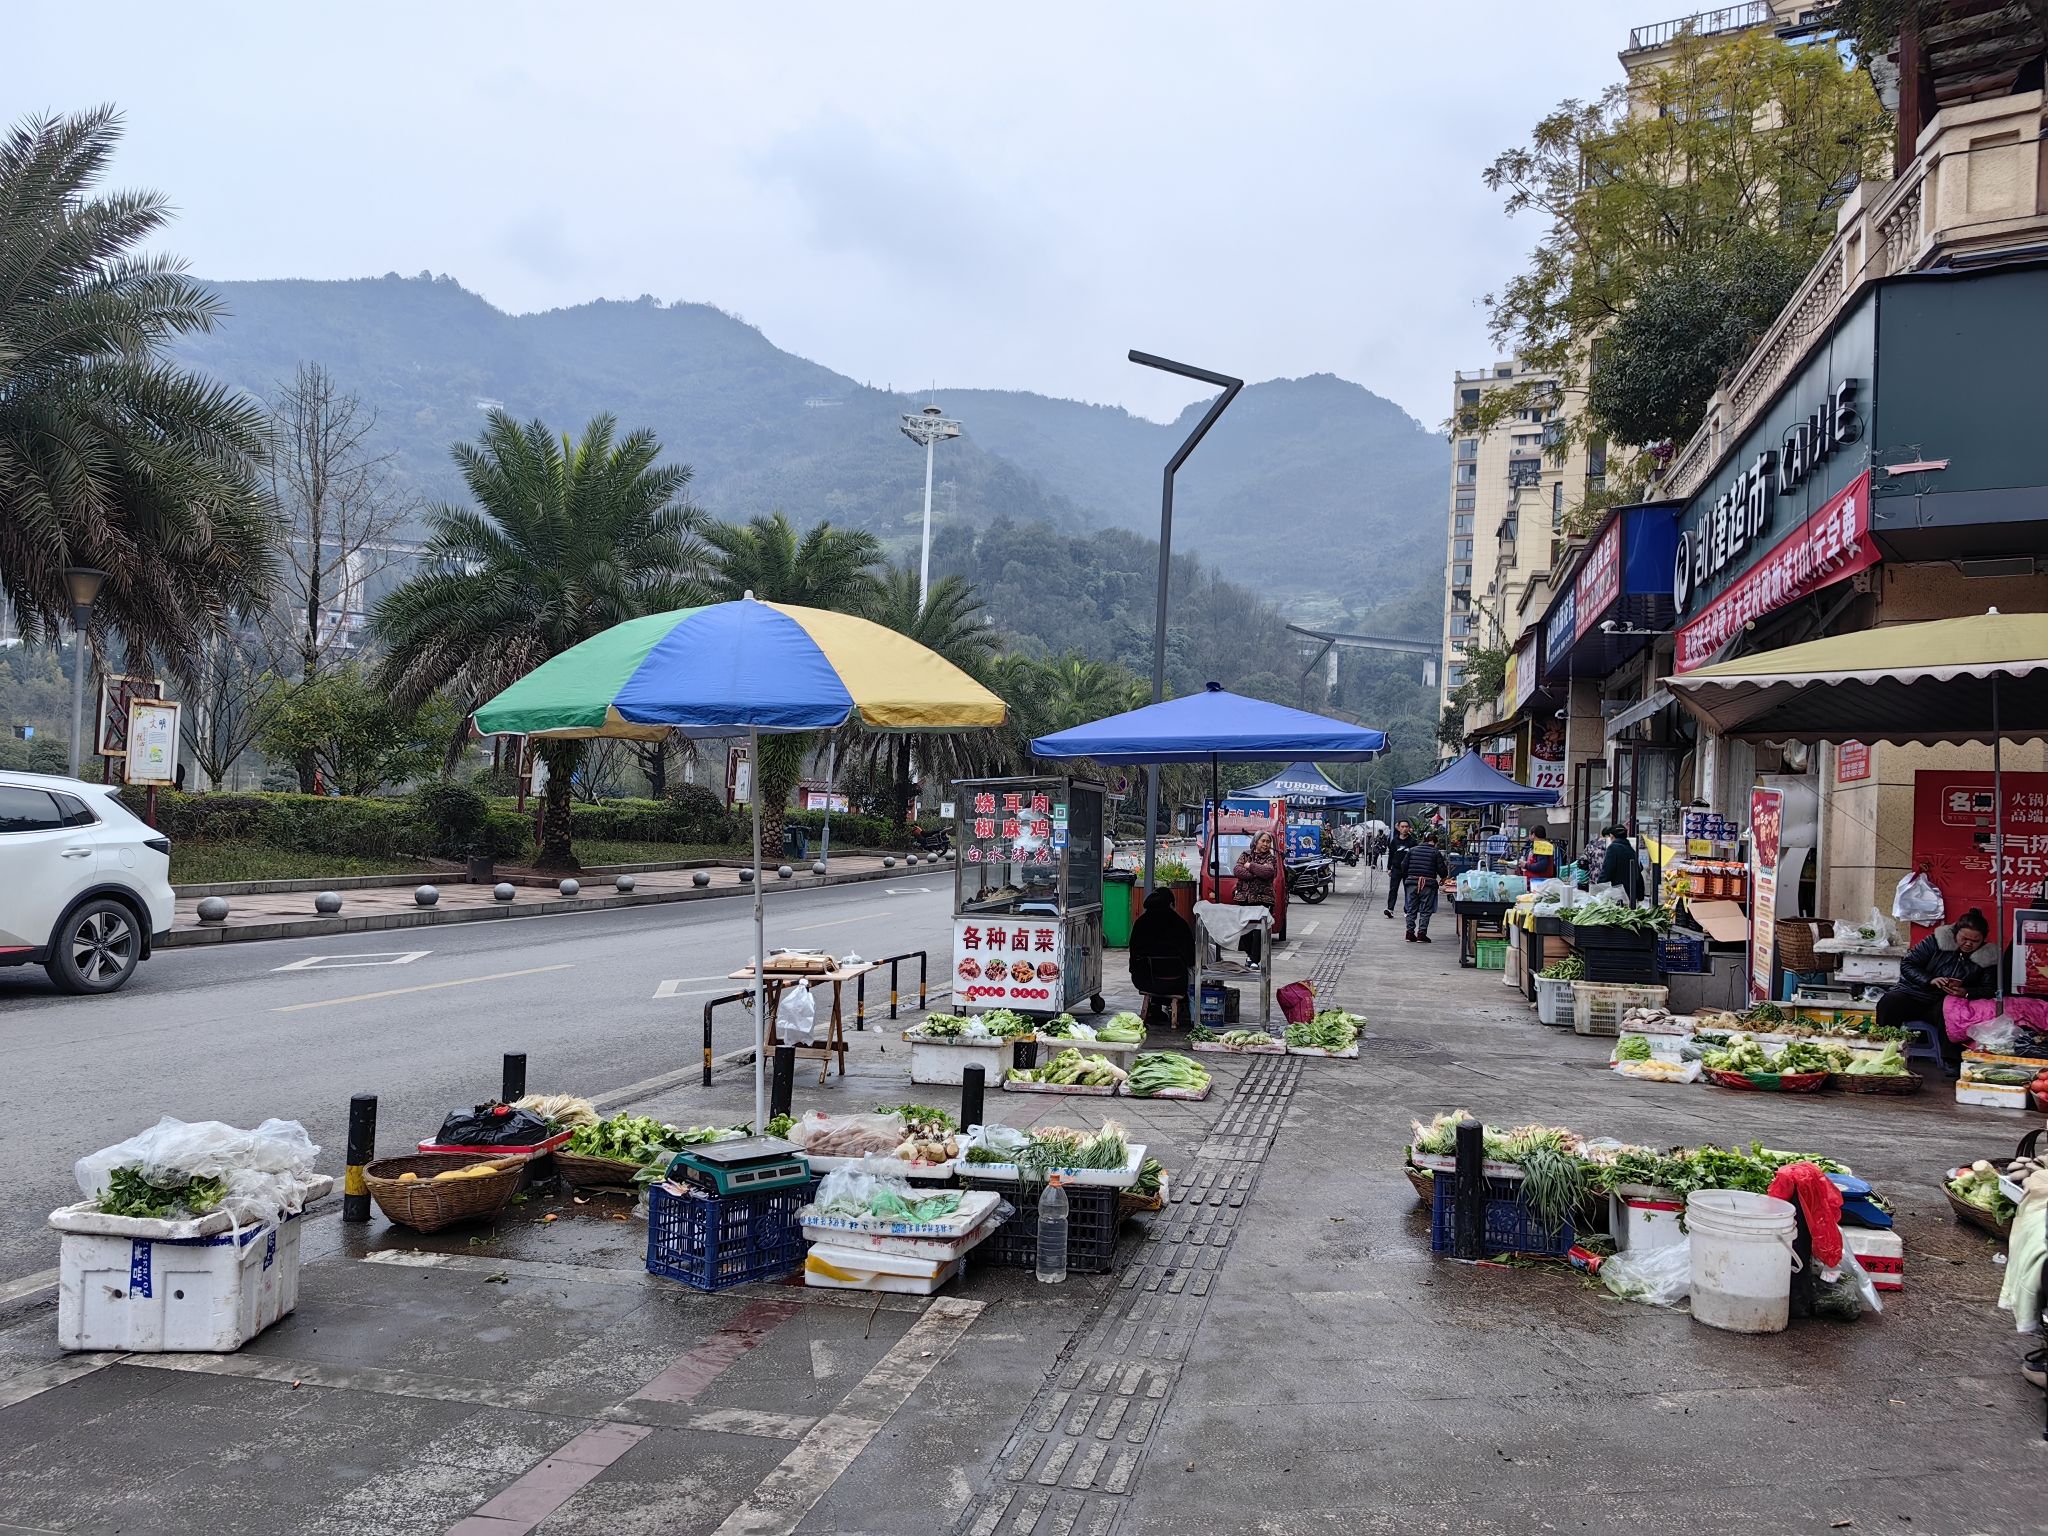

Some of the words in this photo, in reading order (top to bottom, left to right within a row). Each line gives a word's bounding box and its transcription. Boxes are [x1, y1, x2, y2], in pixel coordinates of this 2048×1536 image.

[1778, 379, 1857, 496] KAIJIE
[1694, 453, 1775, 588] 凯捷超市
[1274, 780, 1329, 792] TUBORG
[1536, 773, 1565, 788] 12.9
[975, 793, 1050, 814] 烧耳肉
[1299, 796, 1327, 806] NOT!
[1949, 792, 1995, 812] 名
[2011, 792, 2048, 807] 火锅
[2010, 809, 2048, 823] 高端
[975, 818, 1050, 839] 椒麻鸡
[967, 845, 1052, 865] 白水蹄花
[1989, 855, 2048, 876] 欢乐
[963, 926, 1055, 953] 各种卤菜
